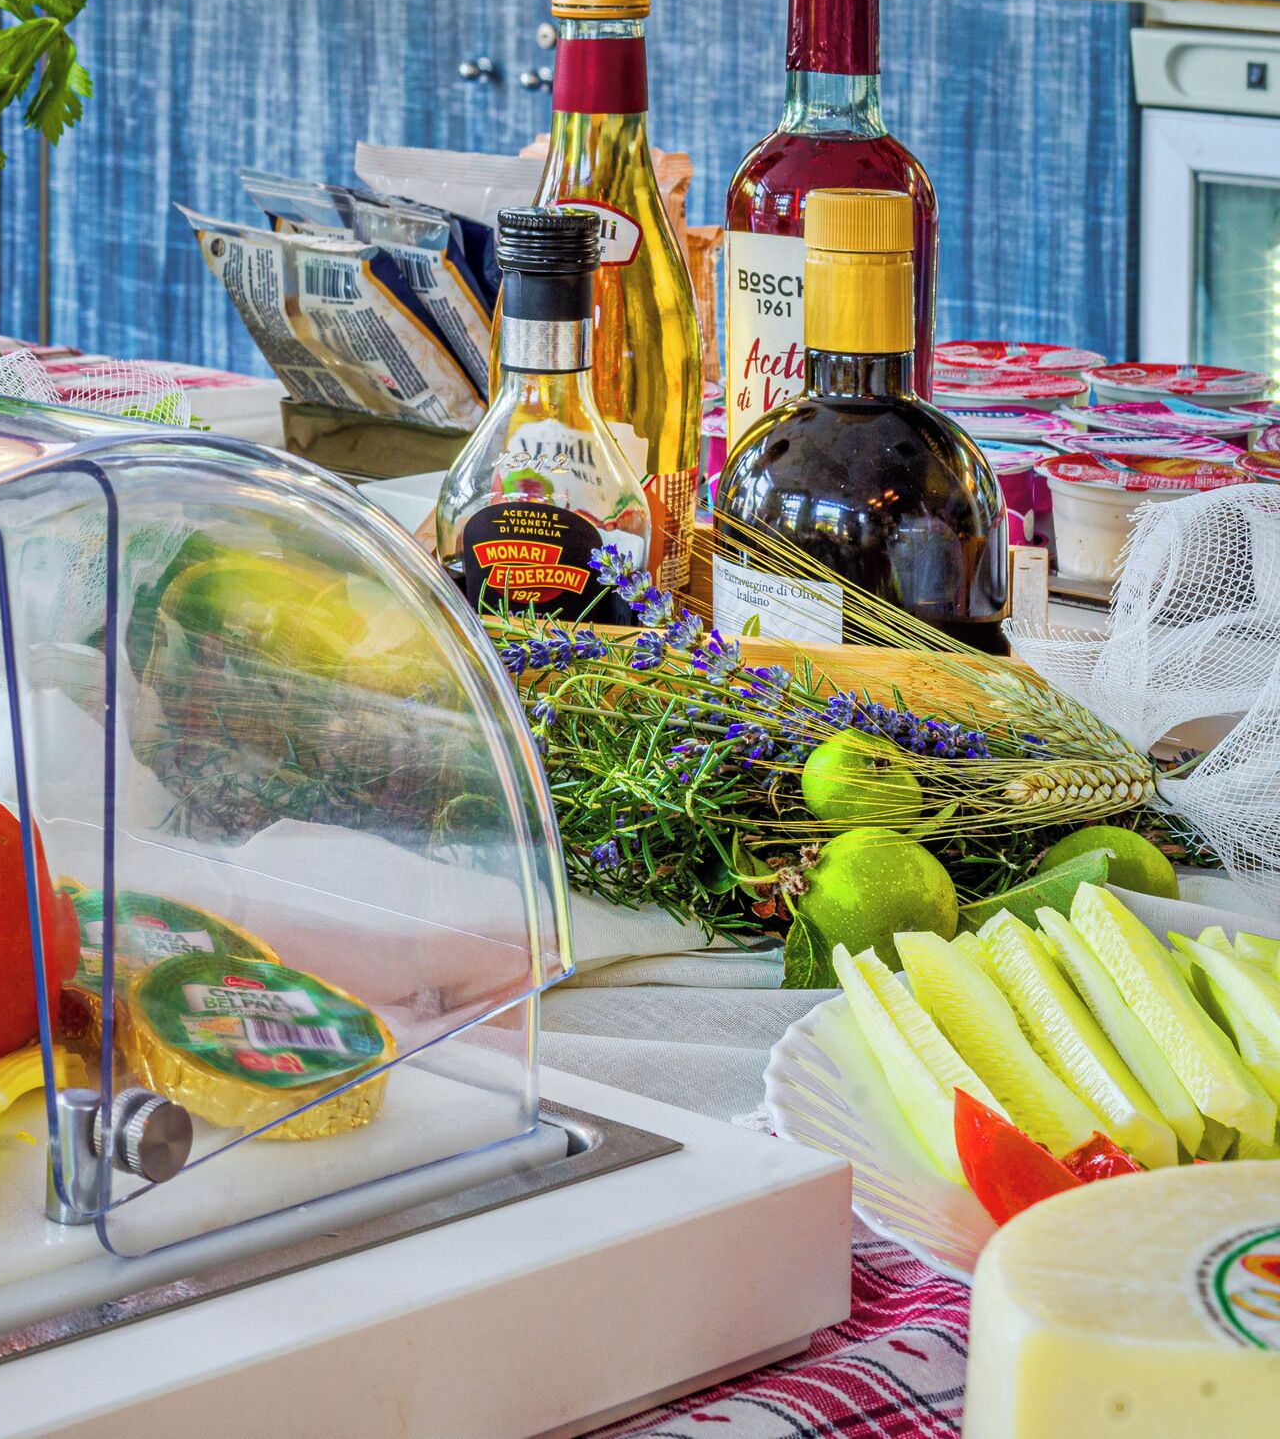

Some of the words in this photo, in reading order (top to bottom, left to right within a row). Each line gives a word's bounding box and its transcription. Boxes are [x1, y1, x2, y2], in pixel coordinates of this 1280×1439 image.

[757, 299, 792, 318] 1961
[737, 386, 752, 411] di
[503, 509, 547, 519] ACETAIA
[552, 513, 559, 521] E
[509, 518, 552, 528] VIGNETI
[514, 527, 561, 538] FAMIGLIA
[486, 545, 546, 562] MONARI
[496, 568, 581, 587] FEDERZONI
[511, 589, 541, 601] 1912
[736, 587, 770, 607] Italiano
[776, 583, 788, 597] di
